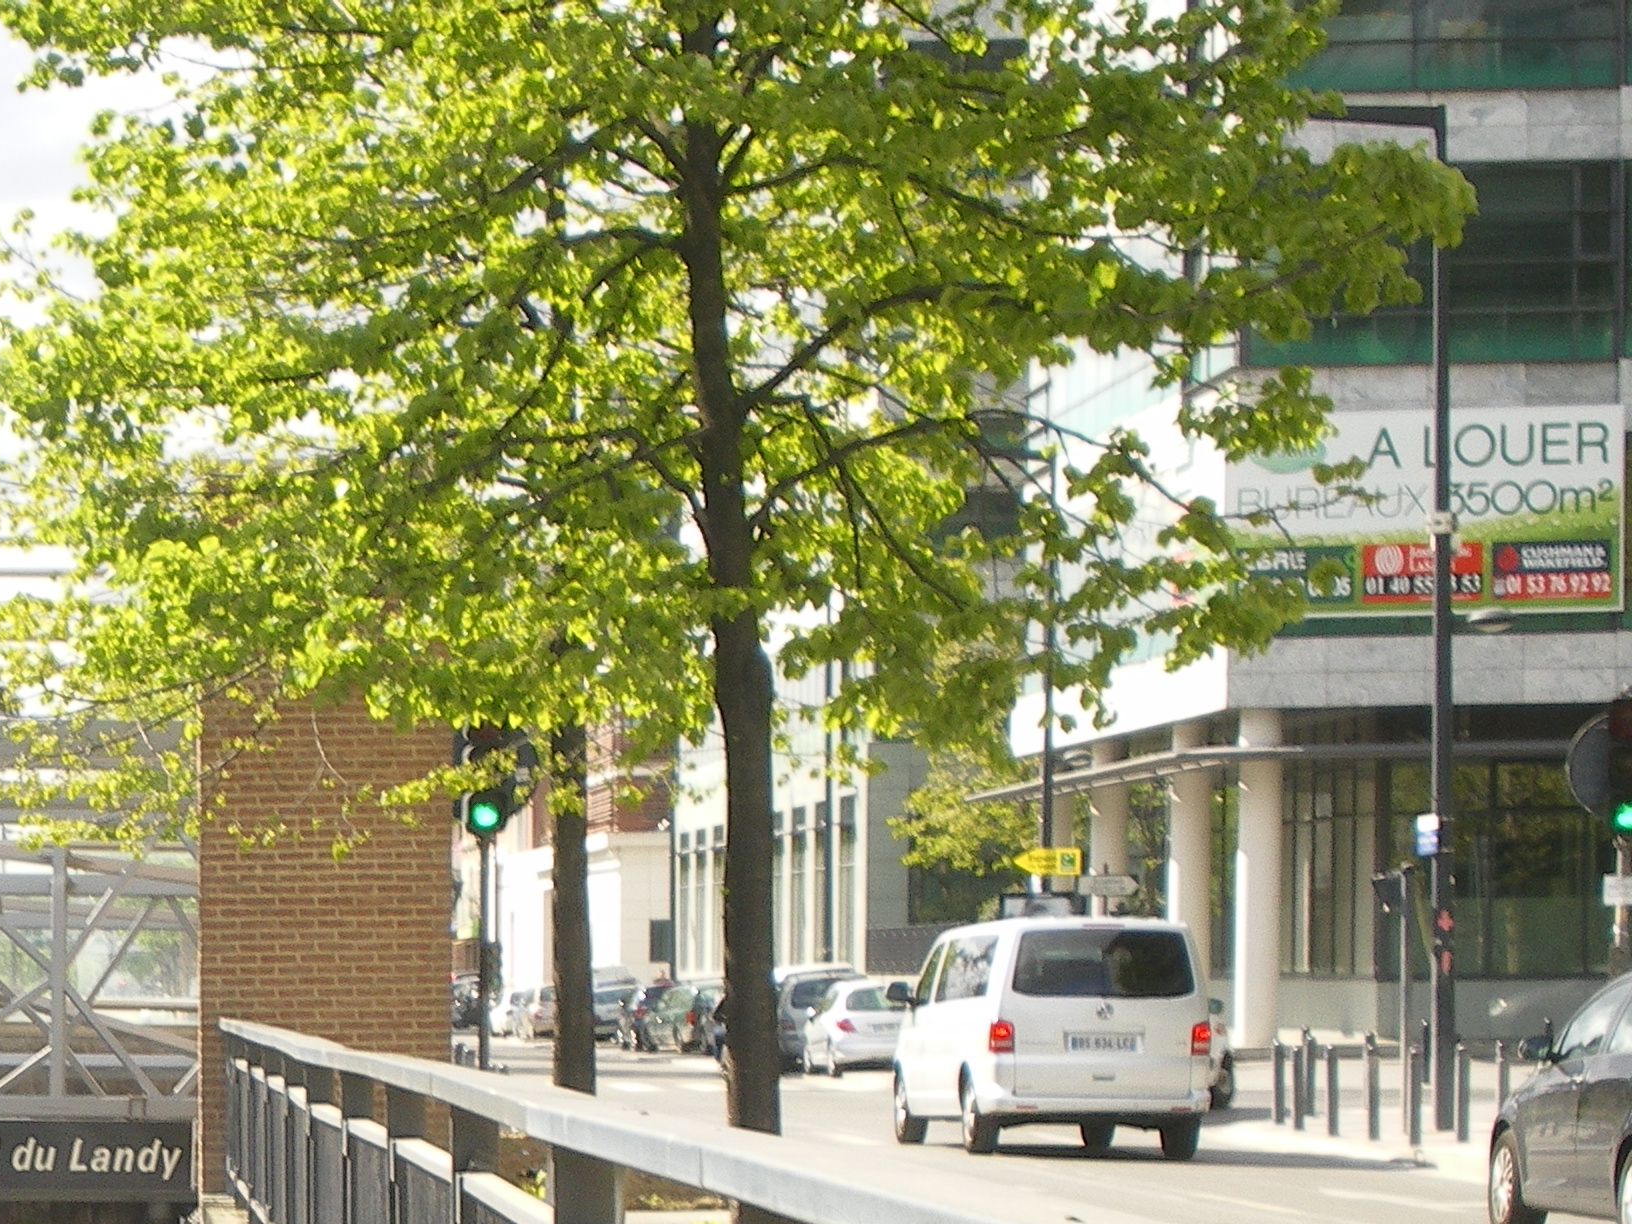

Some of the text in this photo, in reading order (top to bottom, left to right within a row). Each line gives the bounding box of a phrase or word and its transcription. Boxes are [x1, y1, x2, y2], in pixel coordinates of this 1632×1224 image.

[1368, 422, 1610, 468] A LOUER
[1237, 484, 1428, 520] BUREAUX
[1365, 576, 1384, 595] 01
[11, 1137, 57, 1173] du
[68, 1137, 183, 1181] Landy
